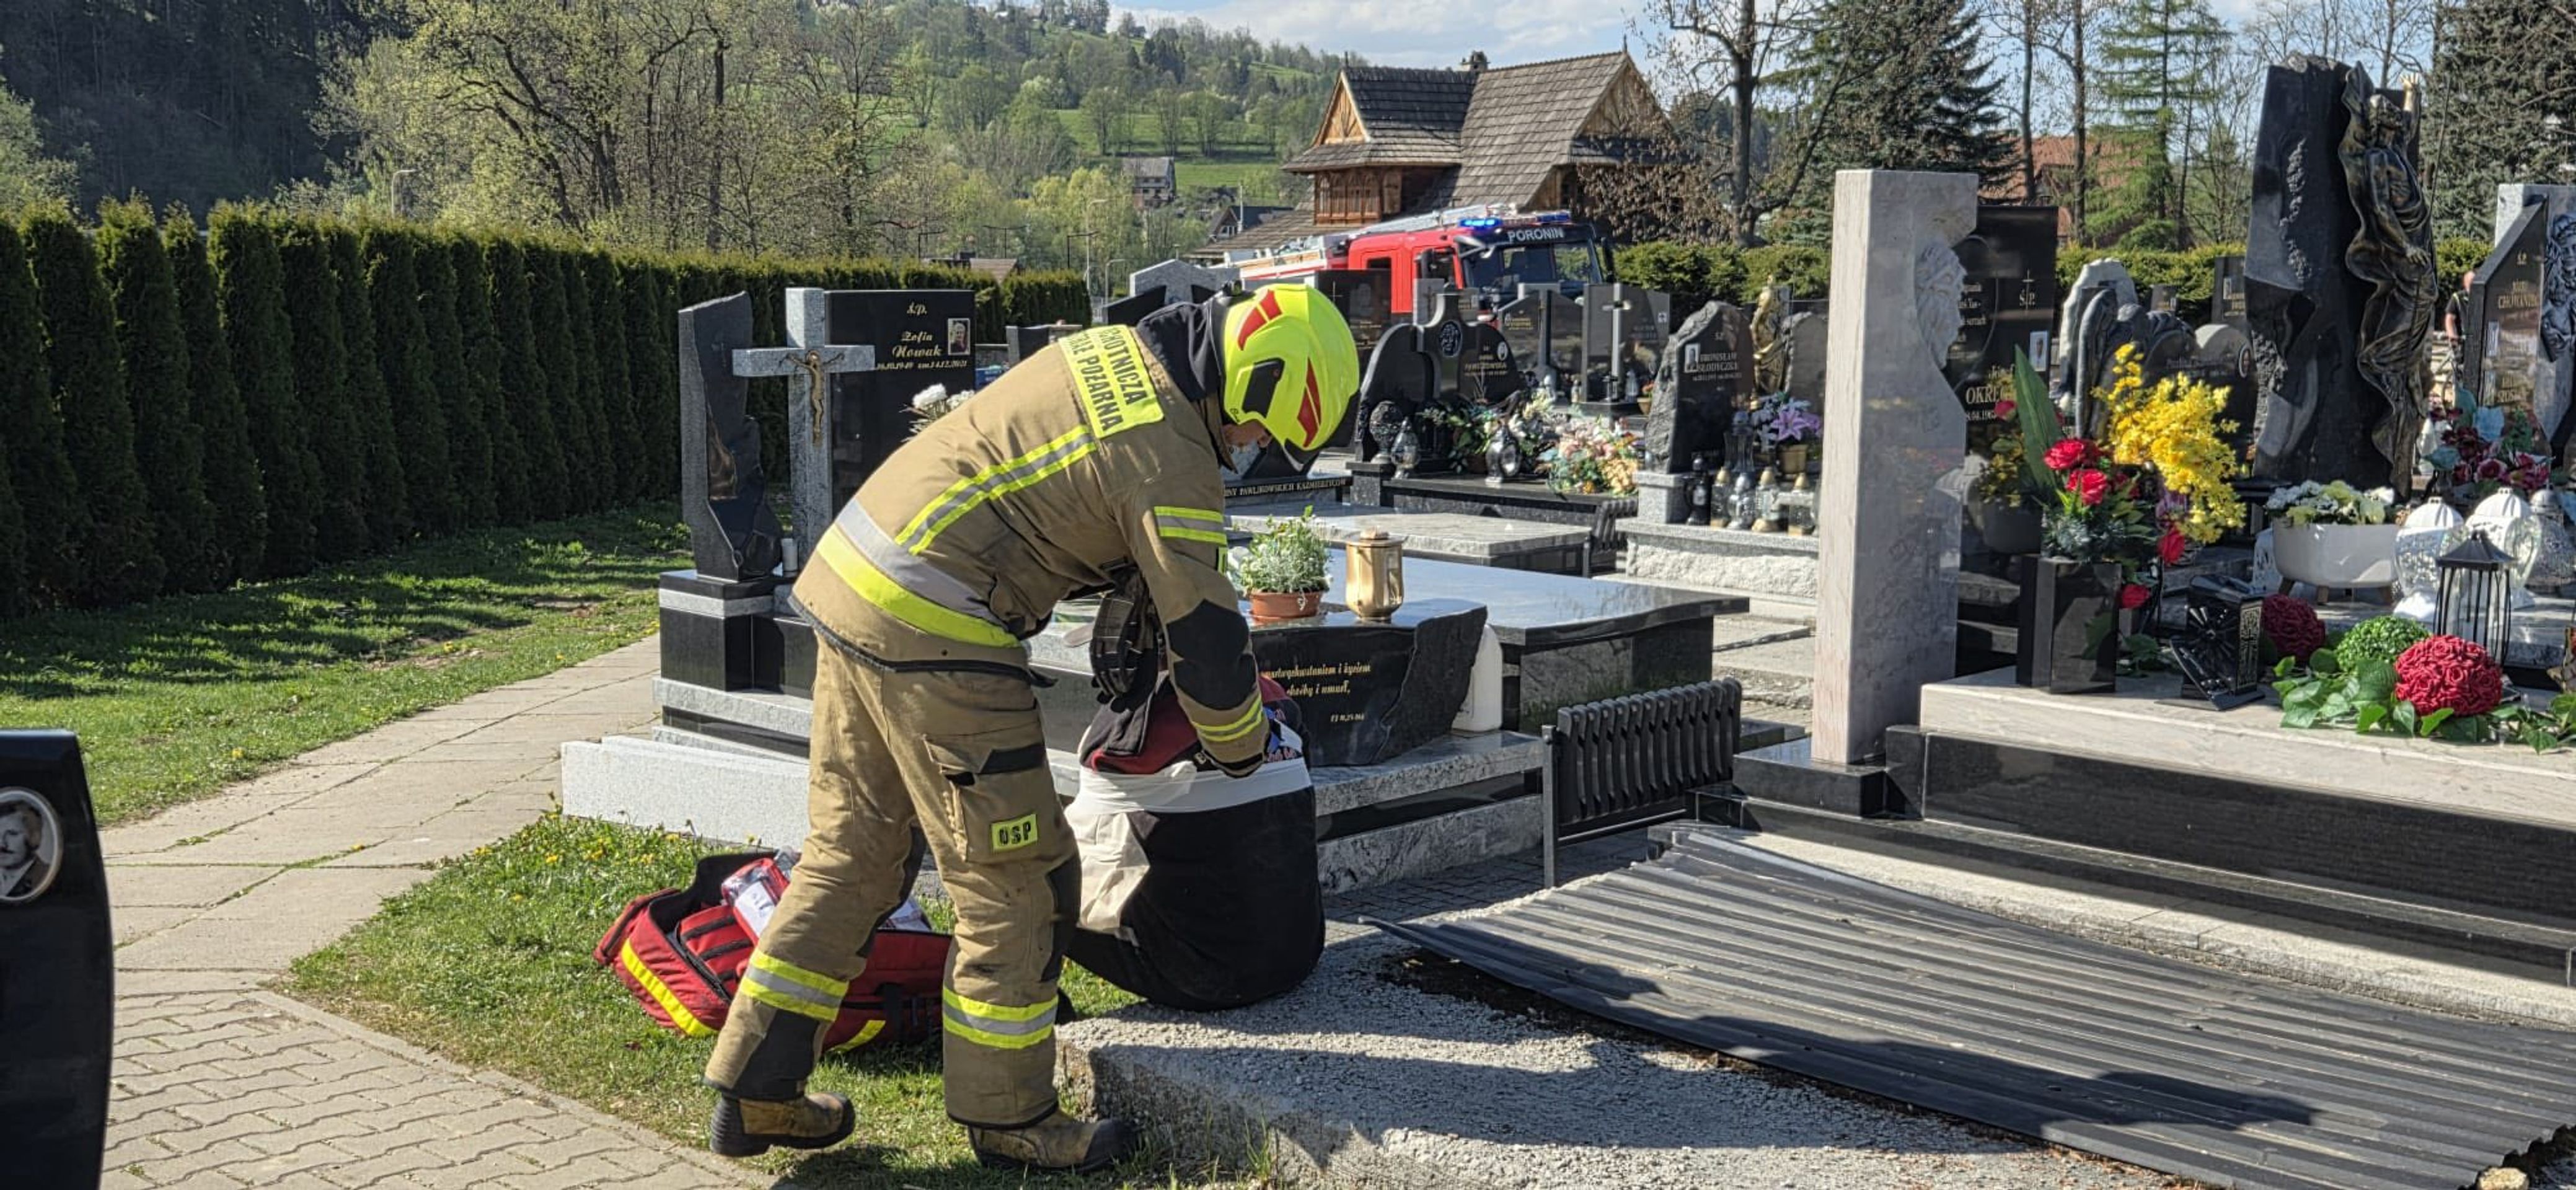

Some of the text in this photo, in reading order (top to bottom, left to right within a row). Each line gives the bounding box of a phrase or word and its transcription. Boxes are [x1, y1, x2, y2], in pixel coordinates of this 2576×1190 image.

[1507, 227, 1564, 243] PORONIN
[901, 330, 933, 343] Zofia
[892, 344, 943, 358] Nowak
[999, 821, 1031, 845] OSP
